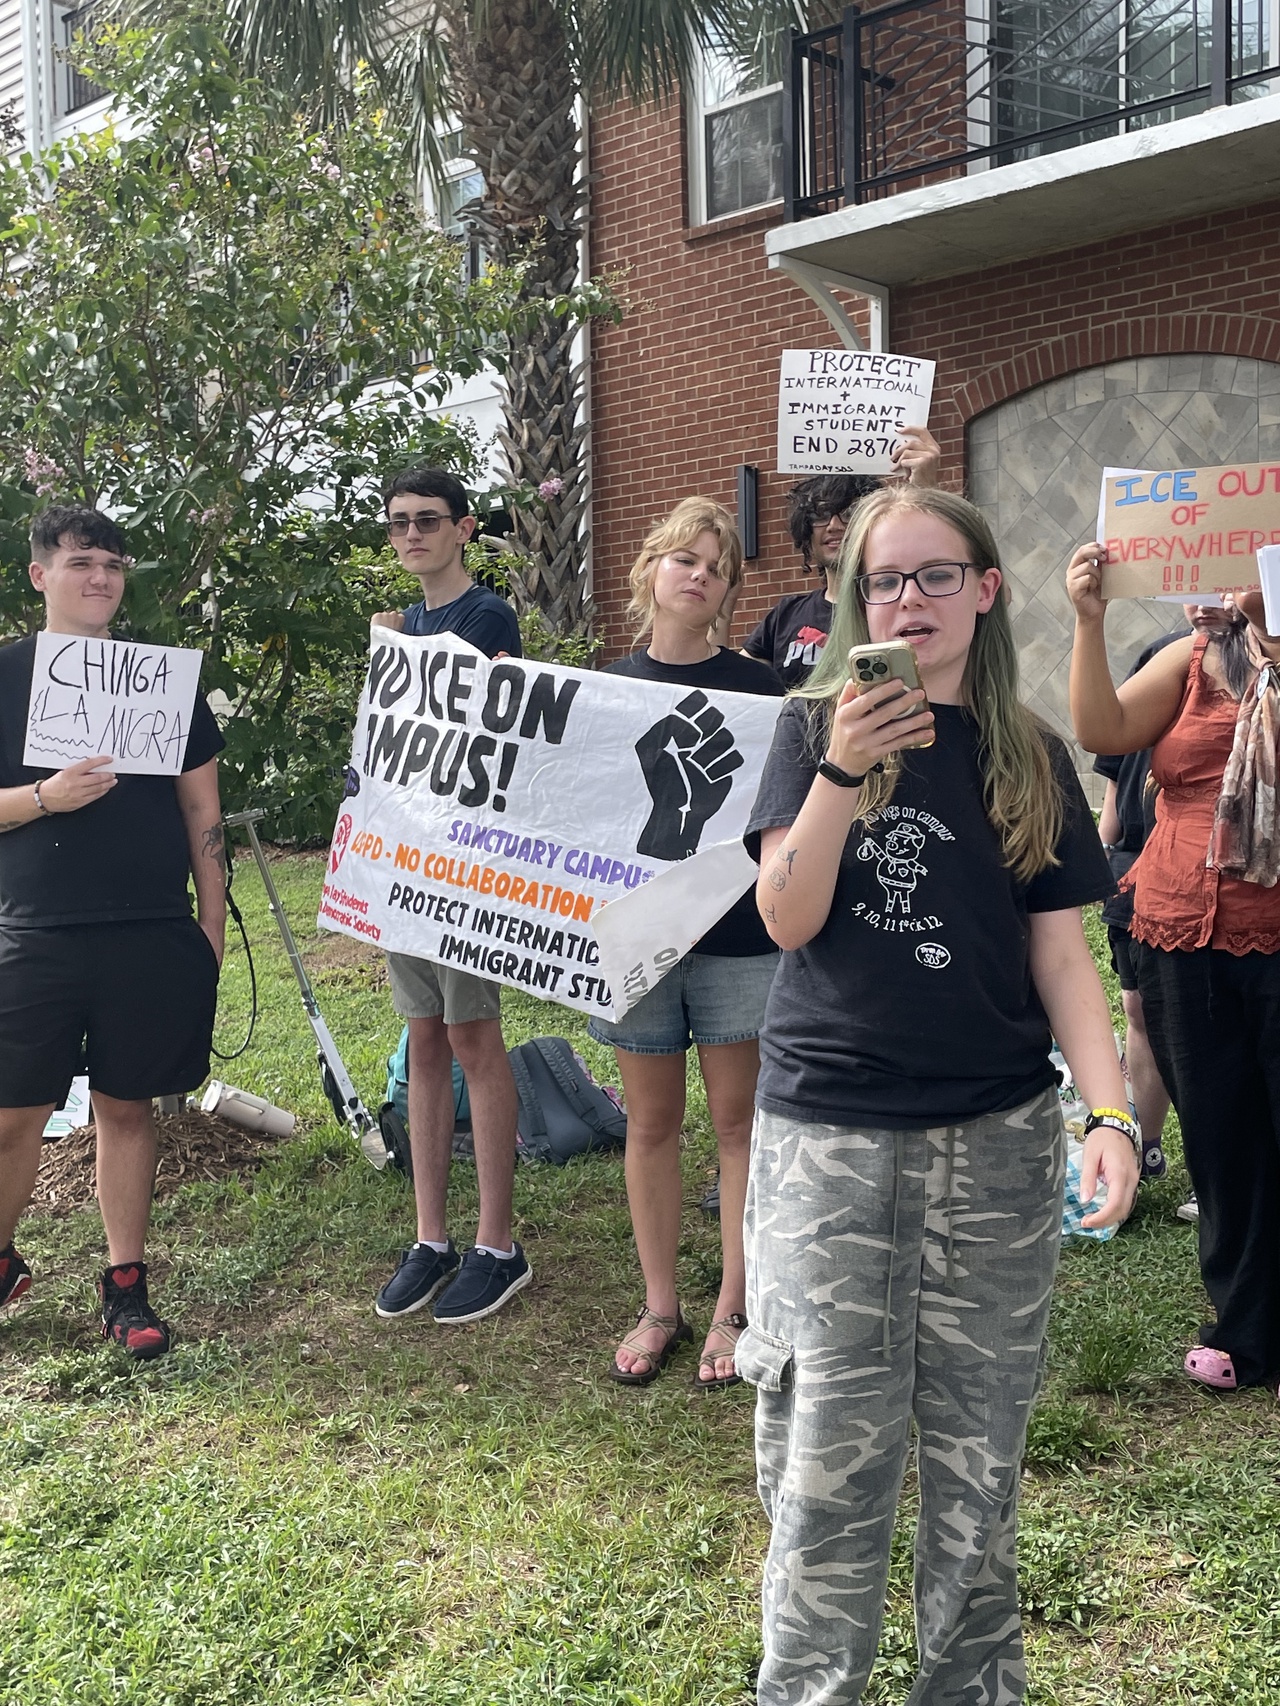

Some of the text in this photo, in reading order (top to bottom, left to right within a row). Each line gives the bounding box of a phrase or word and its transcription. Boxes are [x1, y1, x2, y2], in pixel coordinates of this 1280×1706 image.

[808, 351, 921, 378] PROTECT
[784, 376, 926, 398] INTERNATIONAL
[788, 402, 906, 418] IMMIGRANT
[804, 418, 906, 433] STUDENTS
[793, 436, 902, 458] END 287(
[1115, 470, 1198, 507] ICE
[1171, 503, 1210, 526] OF
[1162, 565, 1200, 592] !!!
[1247, 583, 1260, 592] SD
[49, 639, 173, 697] CHINGA
[783, 641, 822, 668] PU
[40, 686, 89, 735] LA
[413, 650, 478, 725] ICE
[481, 664, 581, 744] ON
[97, 704, 188, 770] MIGRA
[880, 805, 900, 822] pigs
[901, 807, 916, 819] on
[917, 811, 956, 841] campus
[447, 820, 563, 869] SANCTUARY
[394, 843, 421, 872] NO
[424, 853, 594, 923] COLLABORATION
[388, 882, 600, 966] PROTECT INTERNATIO
[851, 902, 866, 917] 9,
[863, 910, 881, 929] 10,
[883, 918, 896, 932] 11
[923, 915, 944, 930] 12
[439, 934, 616, 1007] IMMIGRANT STU
[923, 953, 940, 965] SDS
